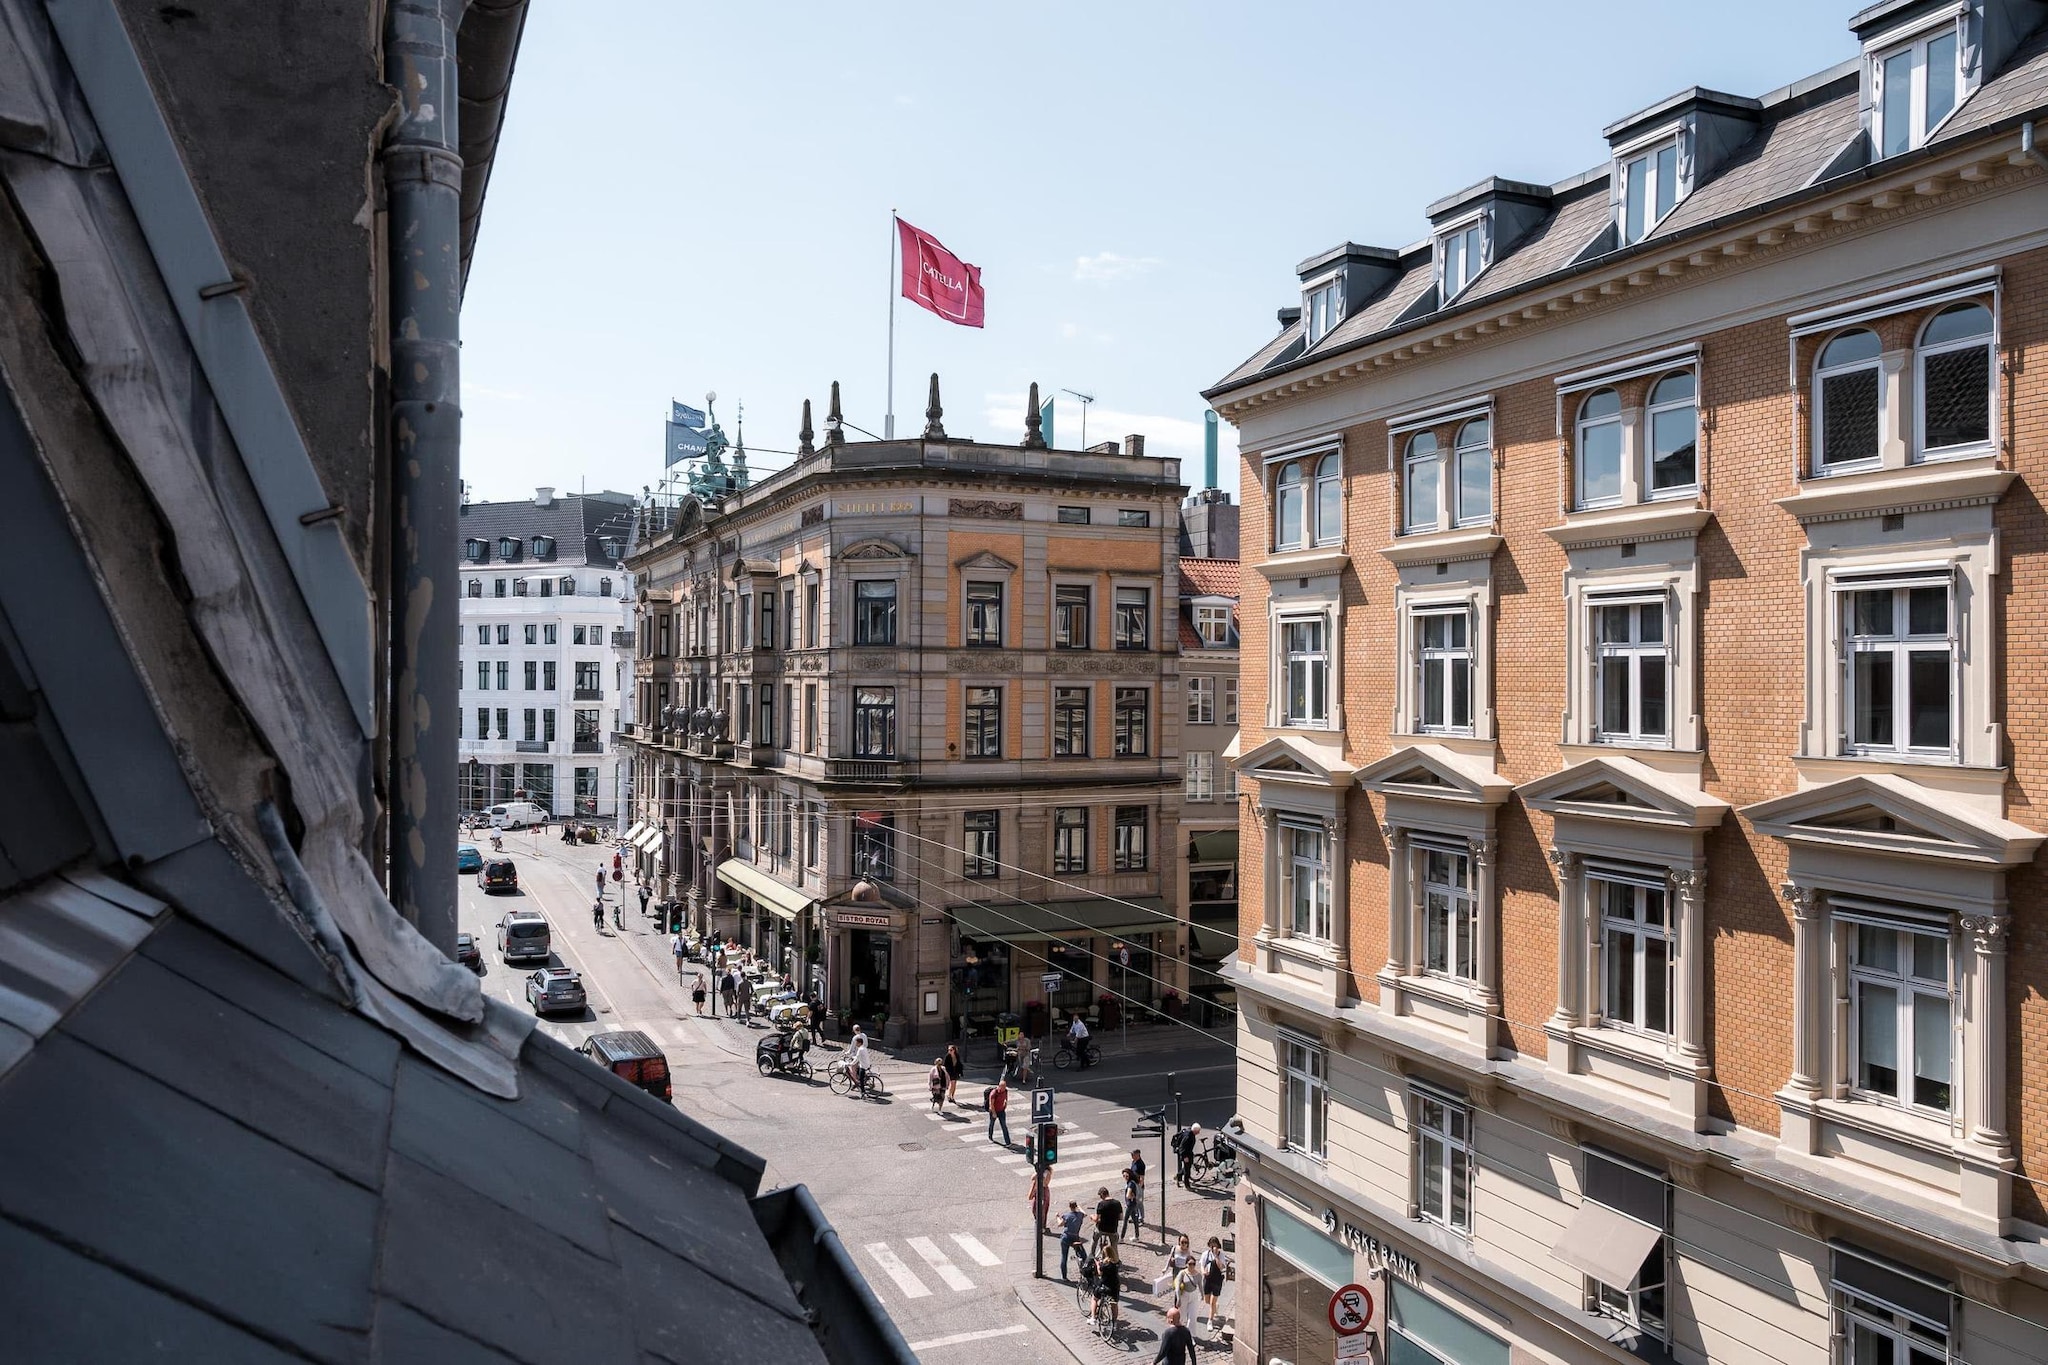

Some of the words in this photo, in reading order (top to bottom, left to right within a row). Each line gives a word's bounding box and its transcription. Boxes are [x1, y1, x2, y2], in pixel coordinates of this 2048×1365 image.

[923, 261, 963, 291] CATELLA
[677, 443, 707, 453] CHANE
[838, 915, 863, 923] BISTRO
[865, 917, 888, 926] ROYAL
[1036, 1092, 1049, 1111] P
[1340, 1225, 1377, 1252] JYSKE
[1381, 1246, 1417, 1277] BANK
